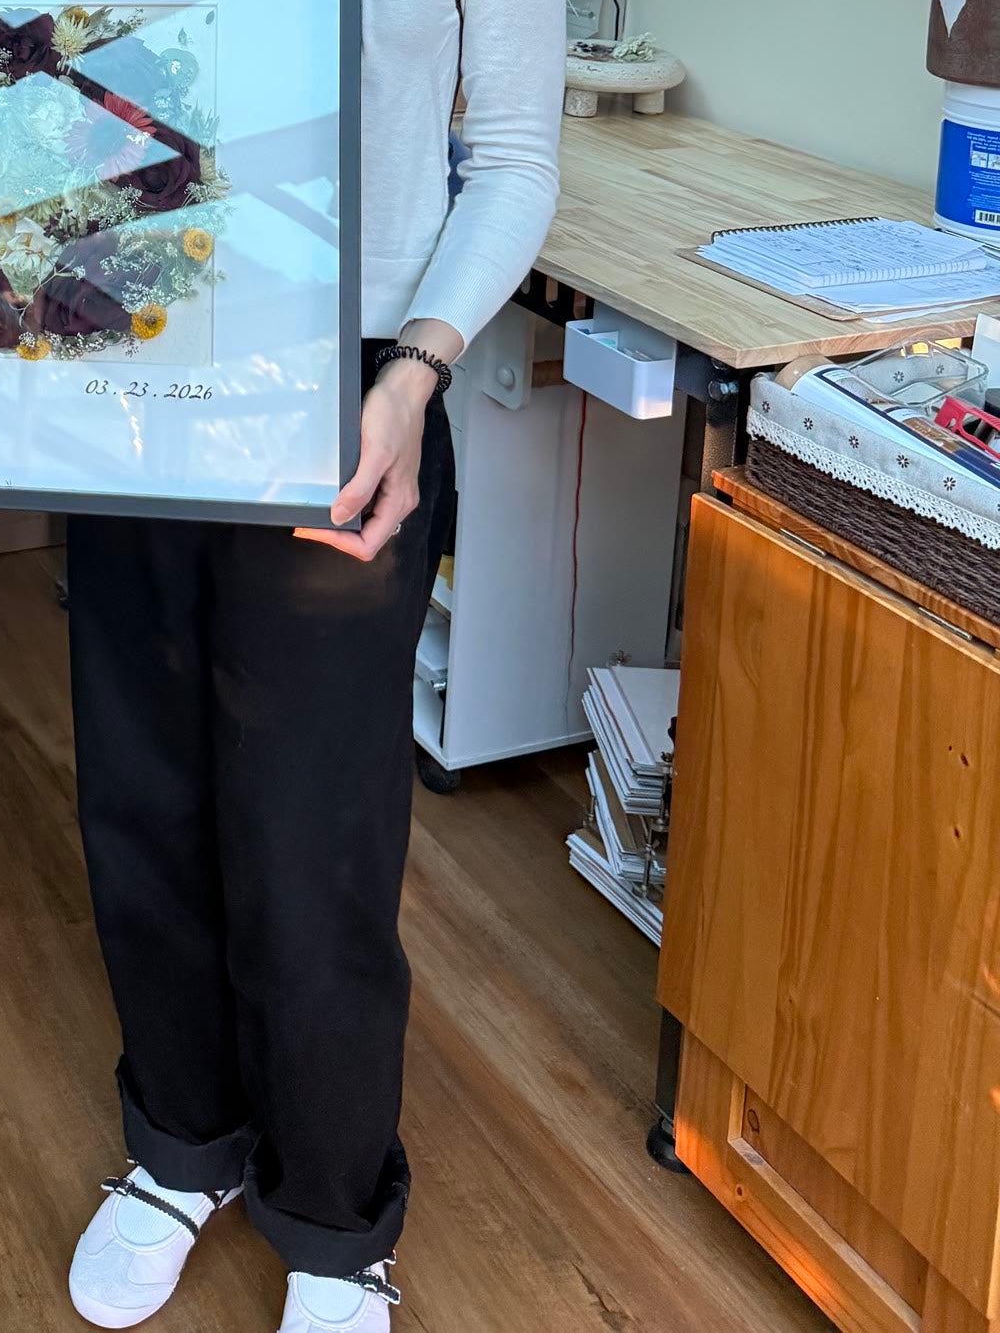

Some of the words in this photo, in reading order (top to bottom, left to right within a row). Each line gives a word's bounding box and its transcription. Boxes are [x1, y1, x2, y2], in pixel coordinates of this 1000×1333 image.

[85, 379, 109, 395] 03
[123, 381, 149, 397] 23
[163, 383, 213, 400] 2026
